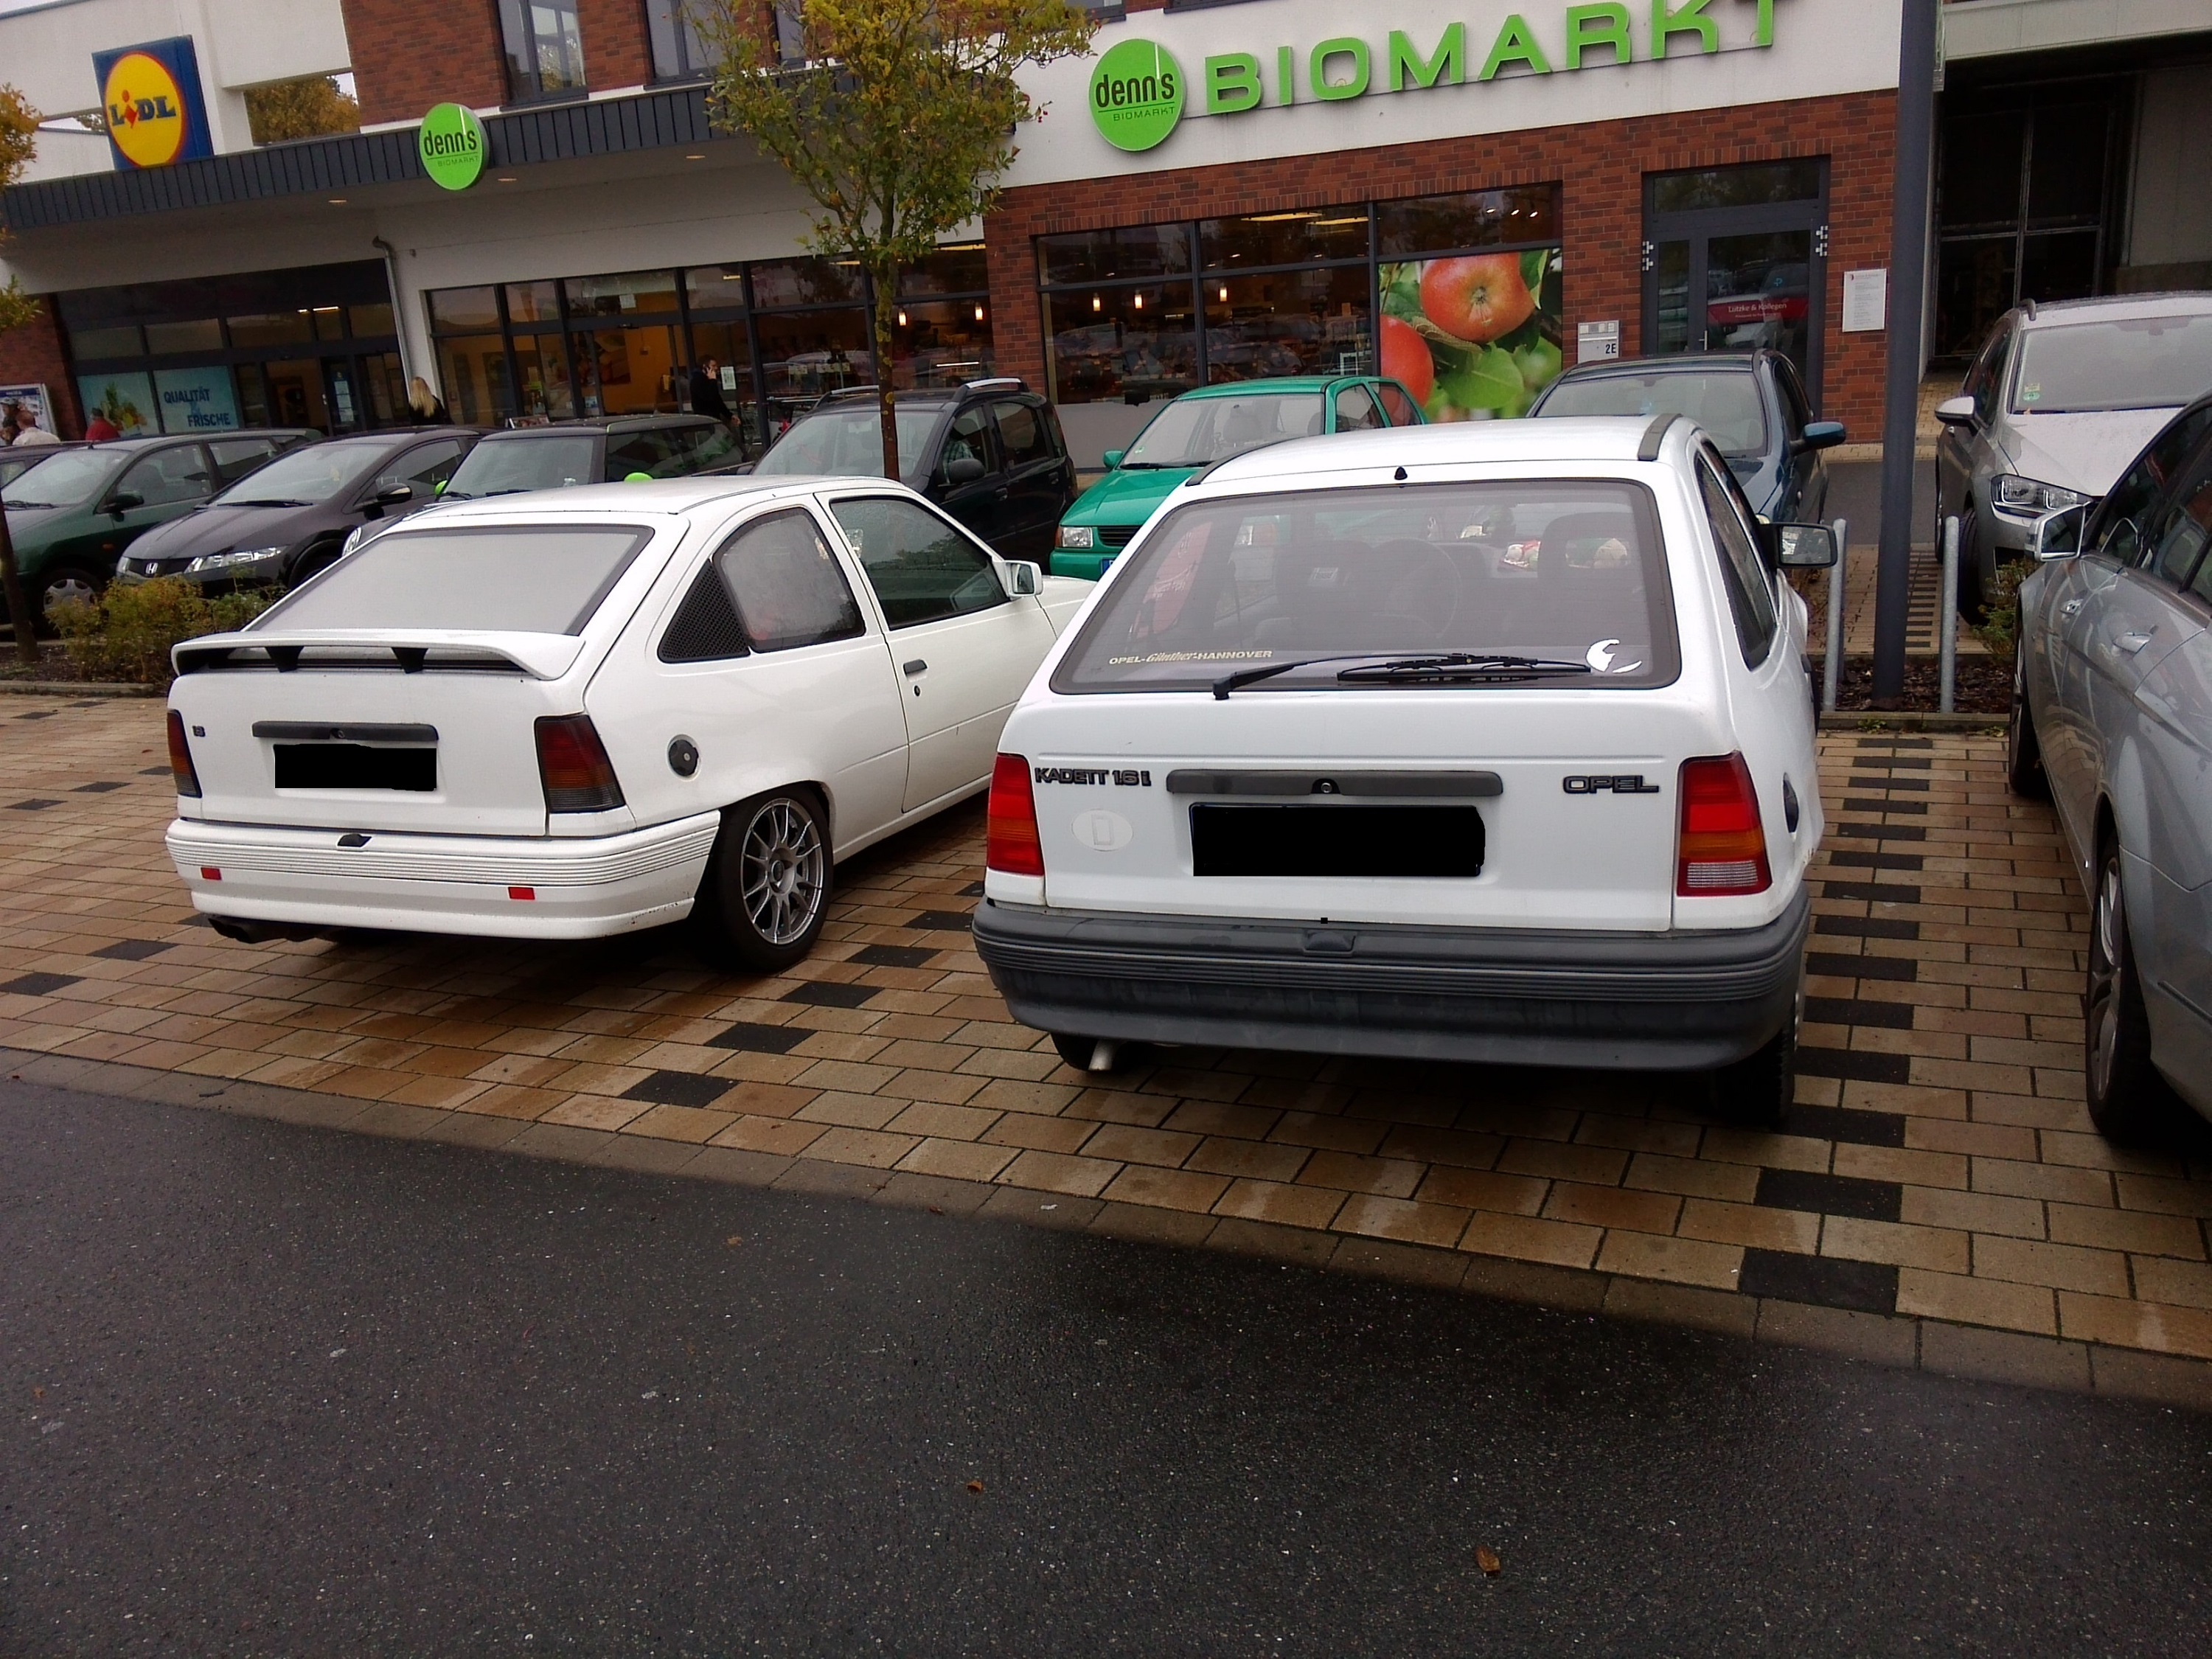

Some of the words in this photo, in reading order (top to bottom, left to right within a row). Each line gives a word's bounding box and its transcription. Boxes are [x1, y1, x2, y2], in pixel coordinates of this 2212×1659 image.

[1113, 106, 1176, 122] BIOMARKT
[437, 156, 479, 167] BIOMARKT
[1605, 343, 1617, 355] 2E
[163, 386, 210, 404] QUALITÄT
[187, 413, 231, 428] FRISCHE
[1034, 767, 1110, 785] KADETT
[1562, 775, 1660, 794] OPEL
